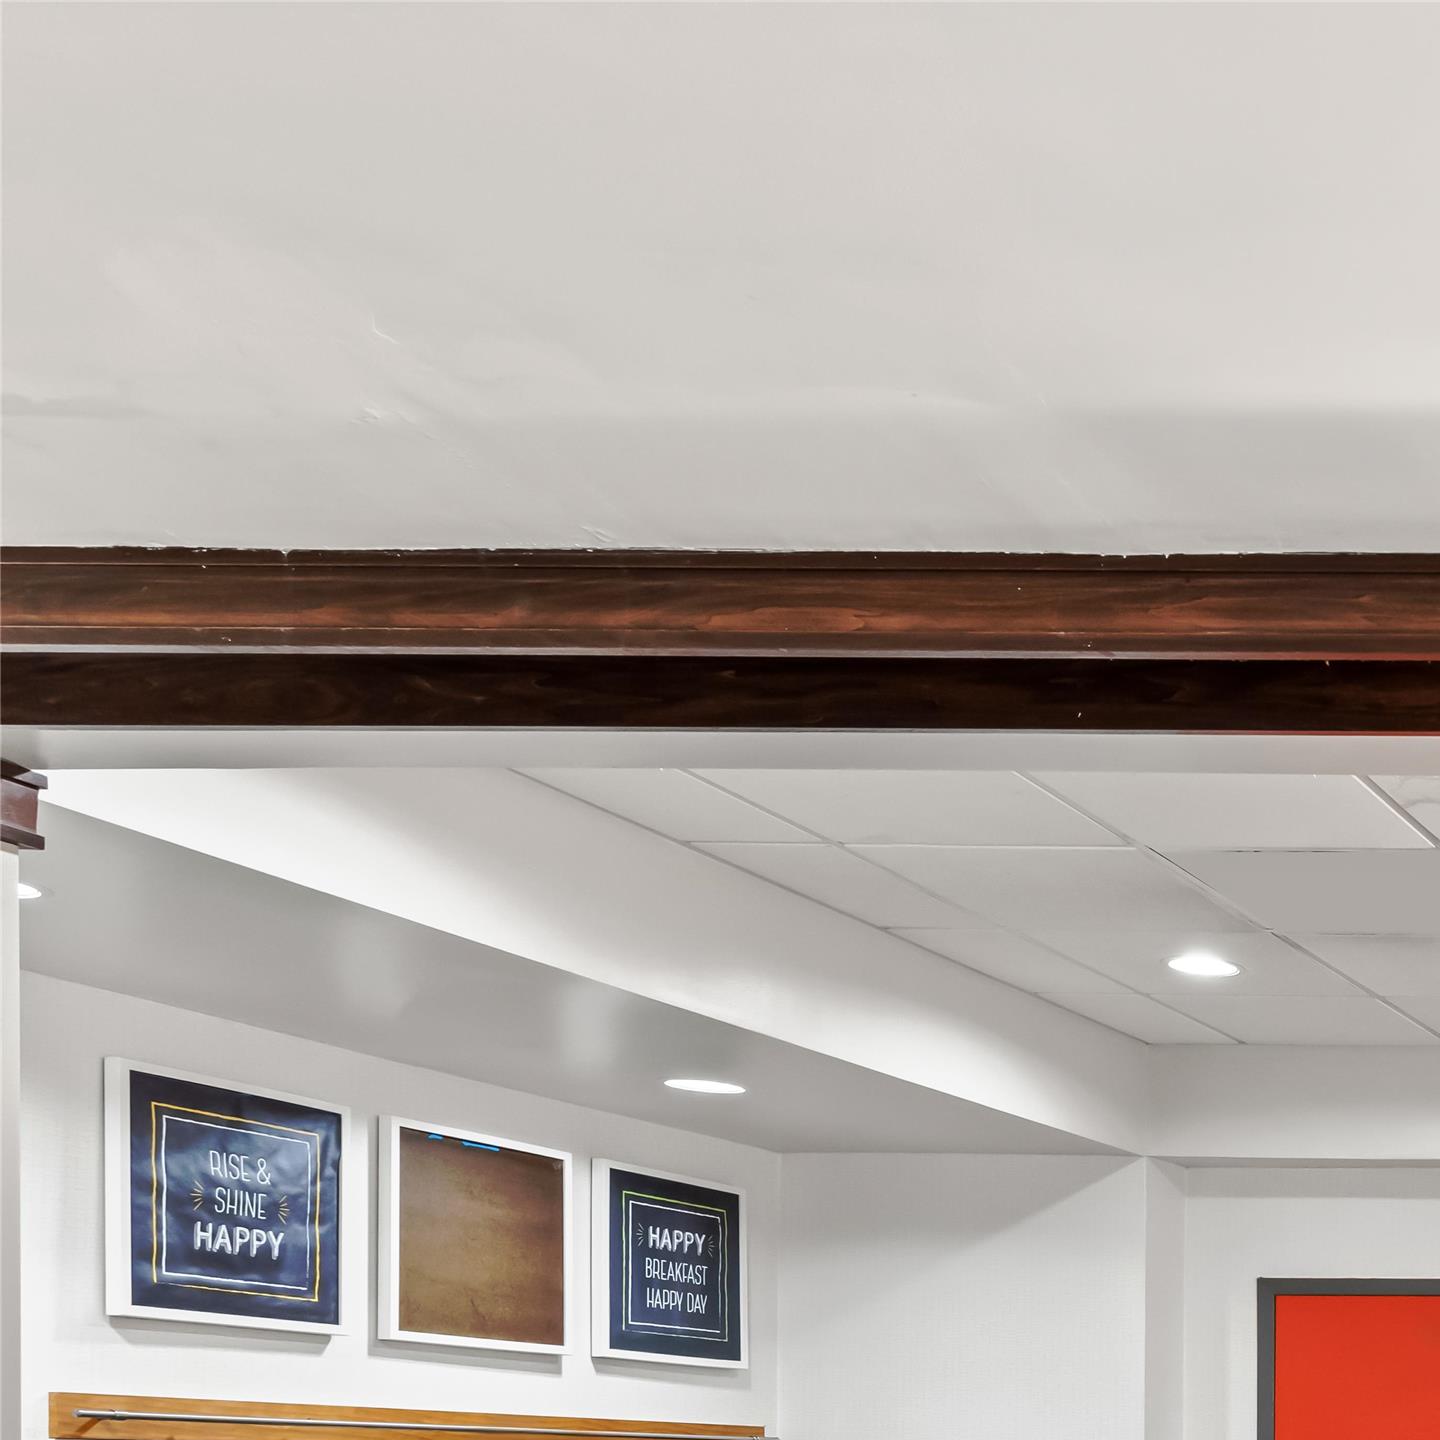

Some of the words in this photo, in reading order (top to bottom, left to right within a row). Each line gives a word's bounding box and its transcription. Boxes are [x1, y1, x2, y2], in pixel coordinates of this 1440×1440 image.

[209, 1150, 251, 1182] RISE
[257, 1158, 271, 1185] &
[215, 1187, 267, 1220] SHINE
[194, 1221, 284, 1260] HAPPY
[648, 1226, 705, 1256] HAPPY
[645, 1257, 708, 1286] BREAKFAST
[647, 1287, 683, 1311] HAPPY
[687, 1292, 707, 1314] DAY
